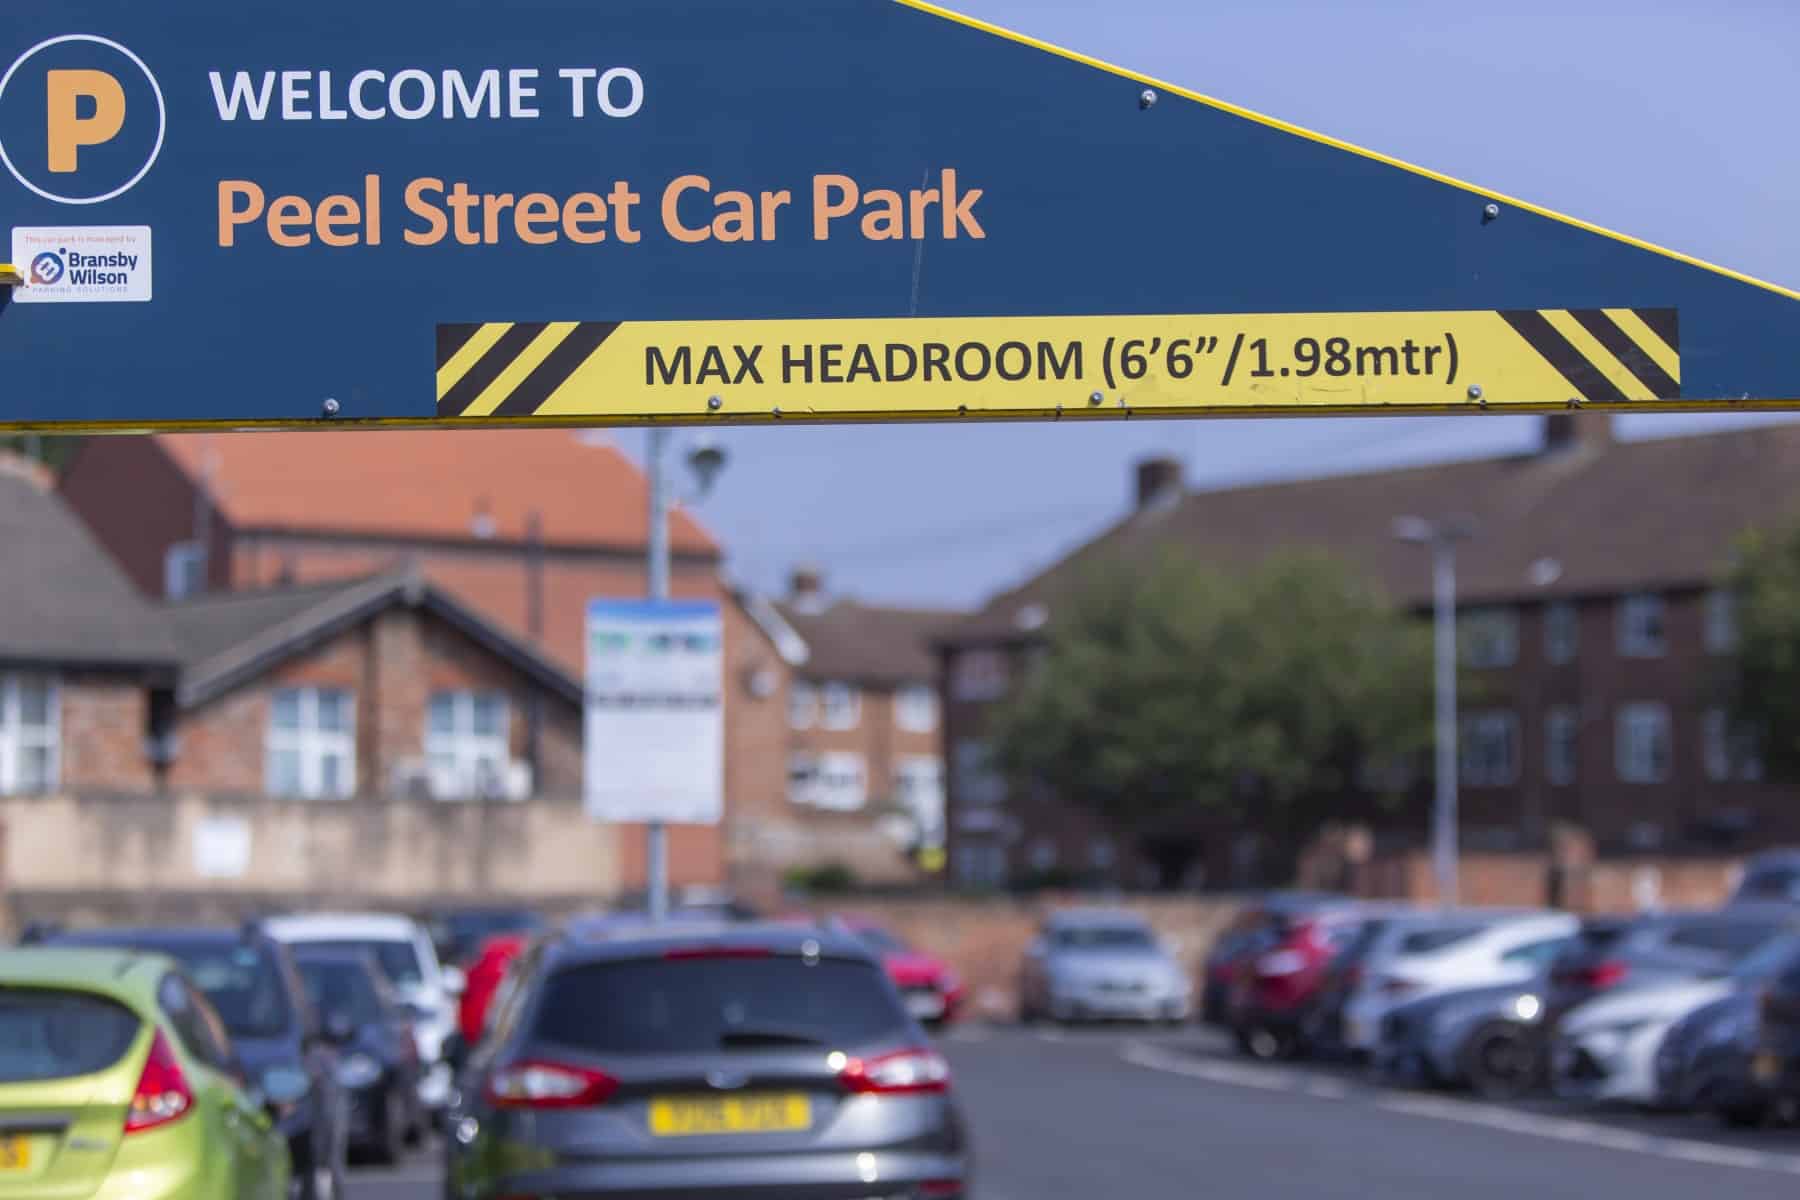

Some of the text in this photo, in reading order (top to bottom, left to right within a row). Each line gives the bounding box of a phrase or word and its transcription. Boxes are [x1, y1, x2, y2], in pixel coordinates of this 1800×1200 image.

[209, 67, 644, 121] WELCOME TO
[48, 69, 125, 172] P
[218, 168, 986, 247] Peel Street Car Park
[69, 252, 138, 271] Bransby
[69, 269, 128, 285] Wilson
[645, 345, 764, 385] MAX
[782, 341, 1083, 383] HEADROOM
